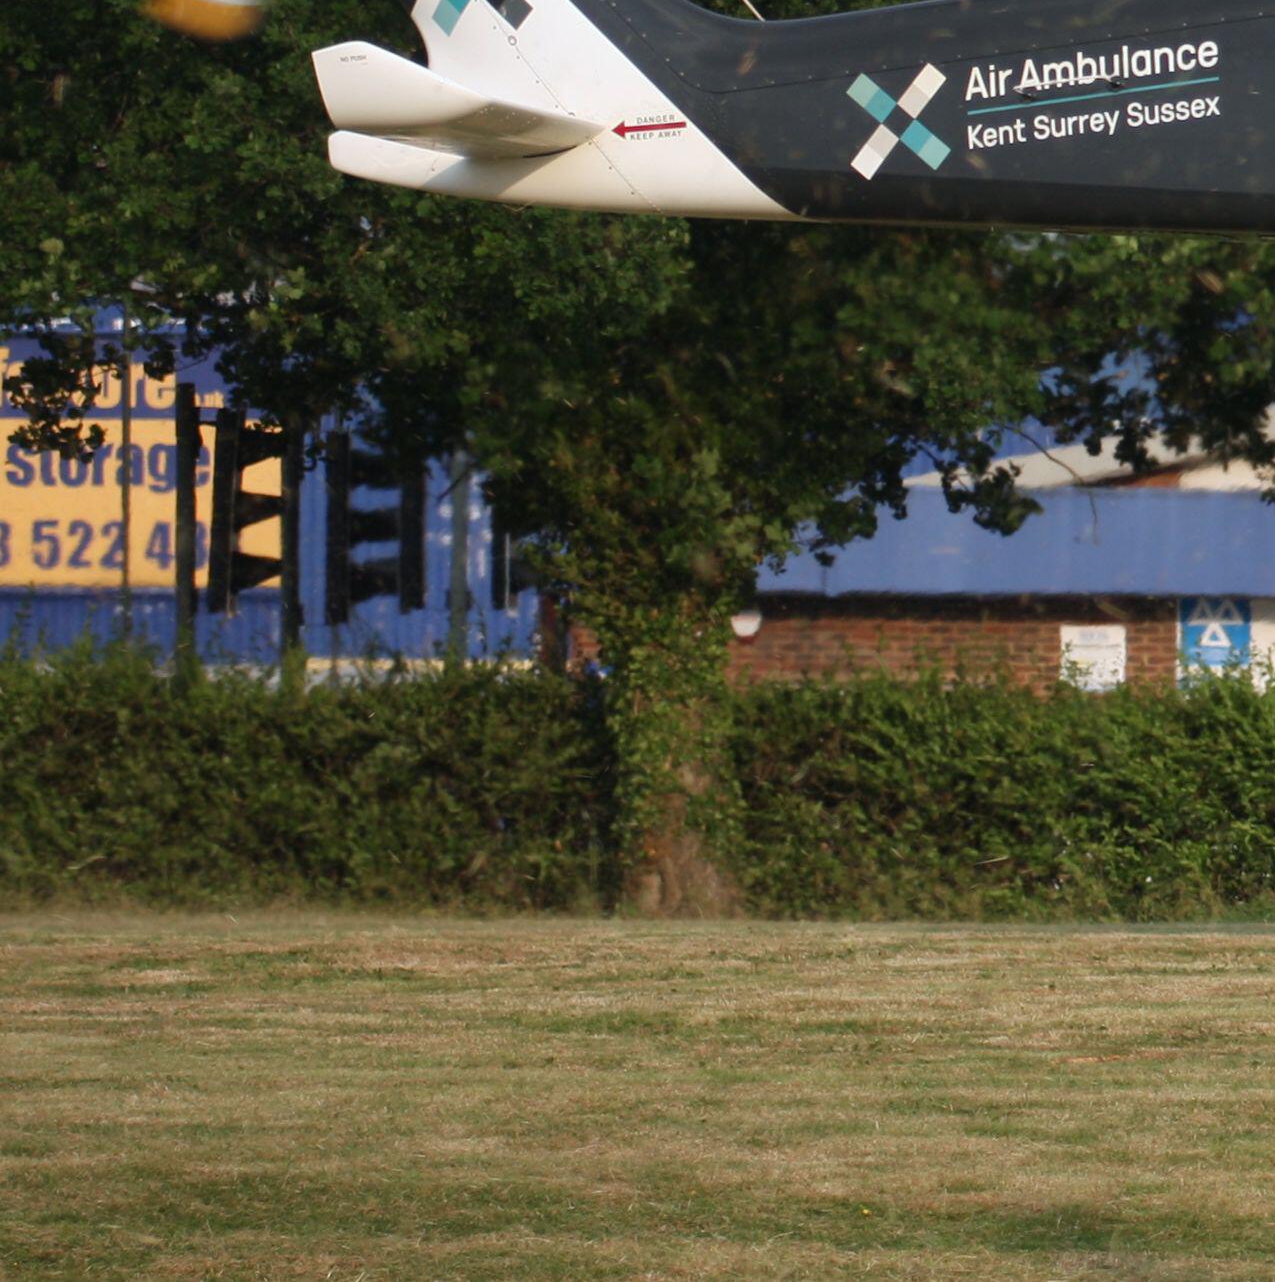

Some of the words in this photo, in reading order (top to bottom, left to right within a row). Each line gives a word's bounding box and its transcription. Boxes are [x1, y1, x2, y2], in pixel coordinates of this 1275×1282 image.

[965, 66, 1013, 101] Air
[1019, 40, 1218, 90] Ambulance
[630, 132, 655, 140] KEEP
[658, 129, 682, 138] AWAY
[636, 114, 675, 125] DANGER
[967, 120, 1026, 150] Kent
[1033, 107, 1120, 140] Surrey
[1126, 95, 1220, 127] Sussex
